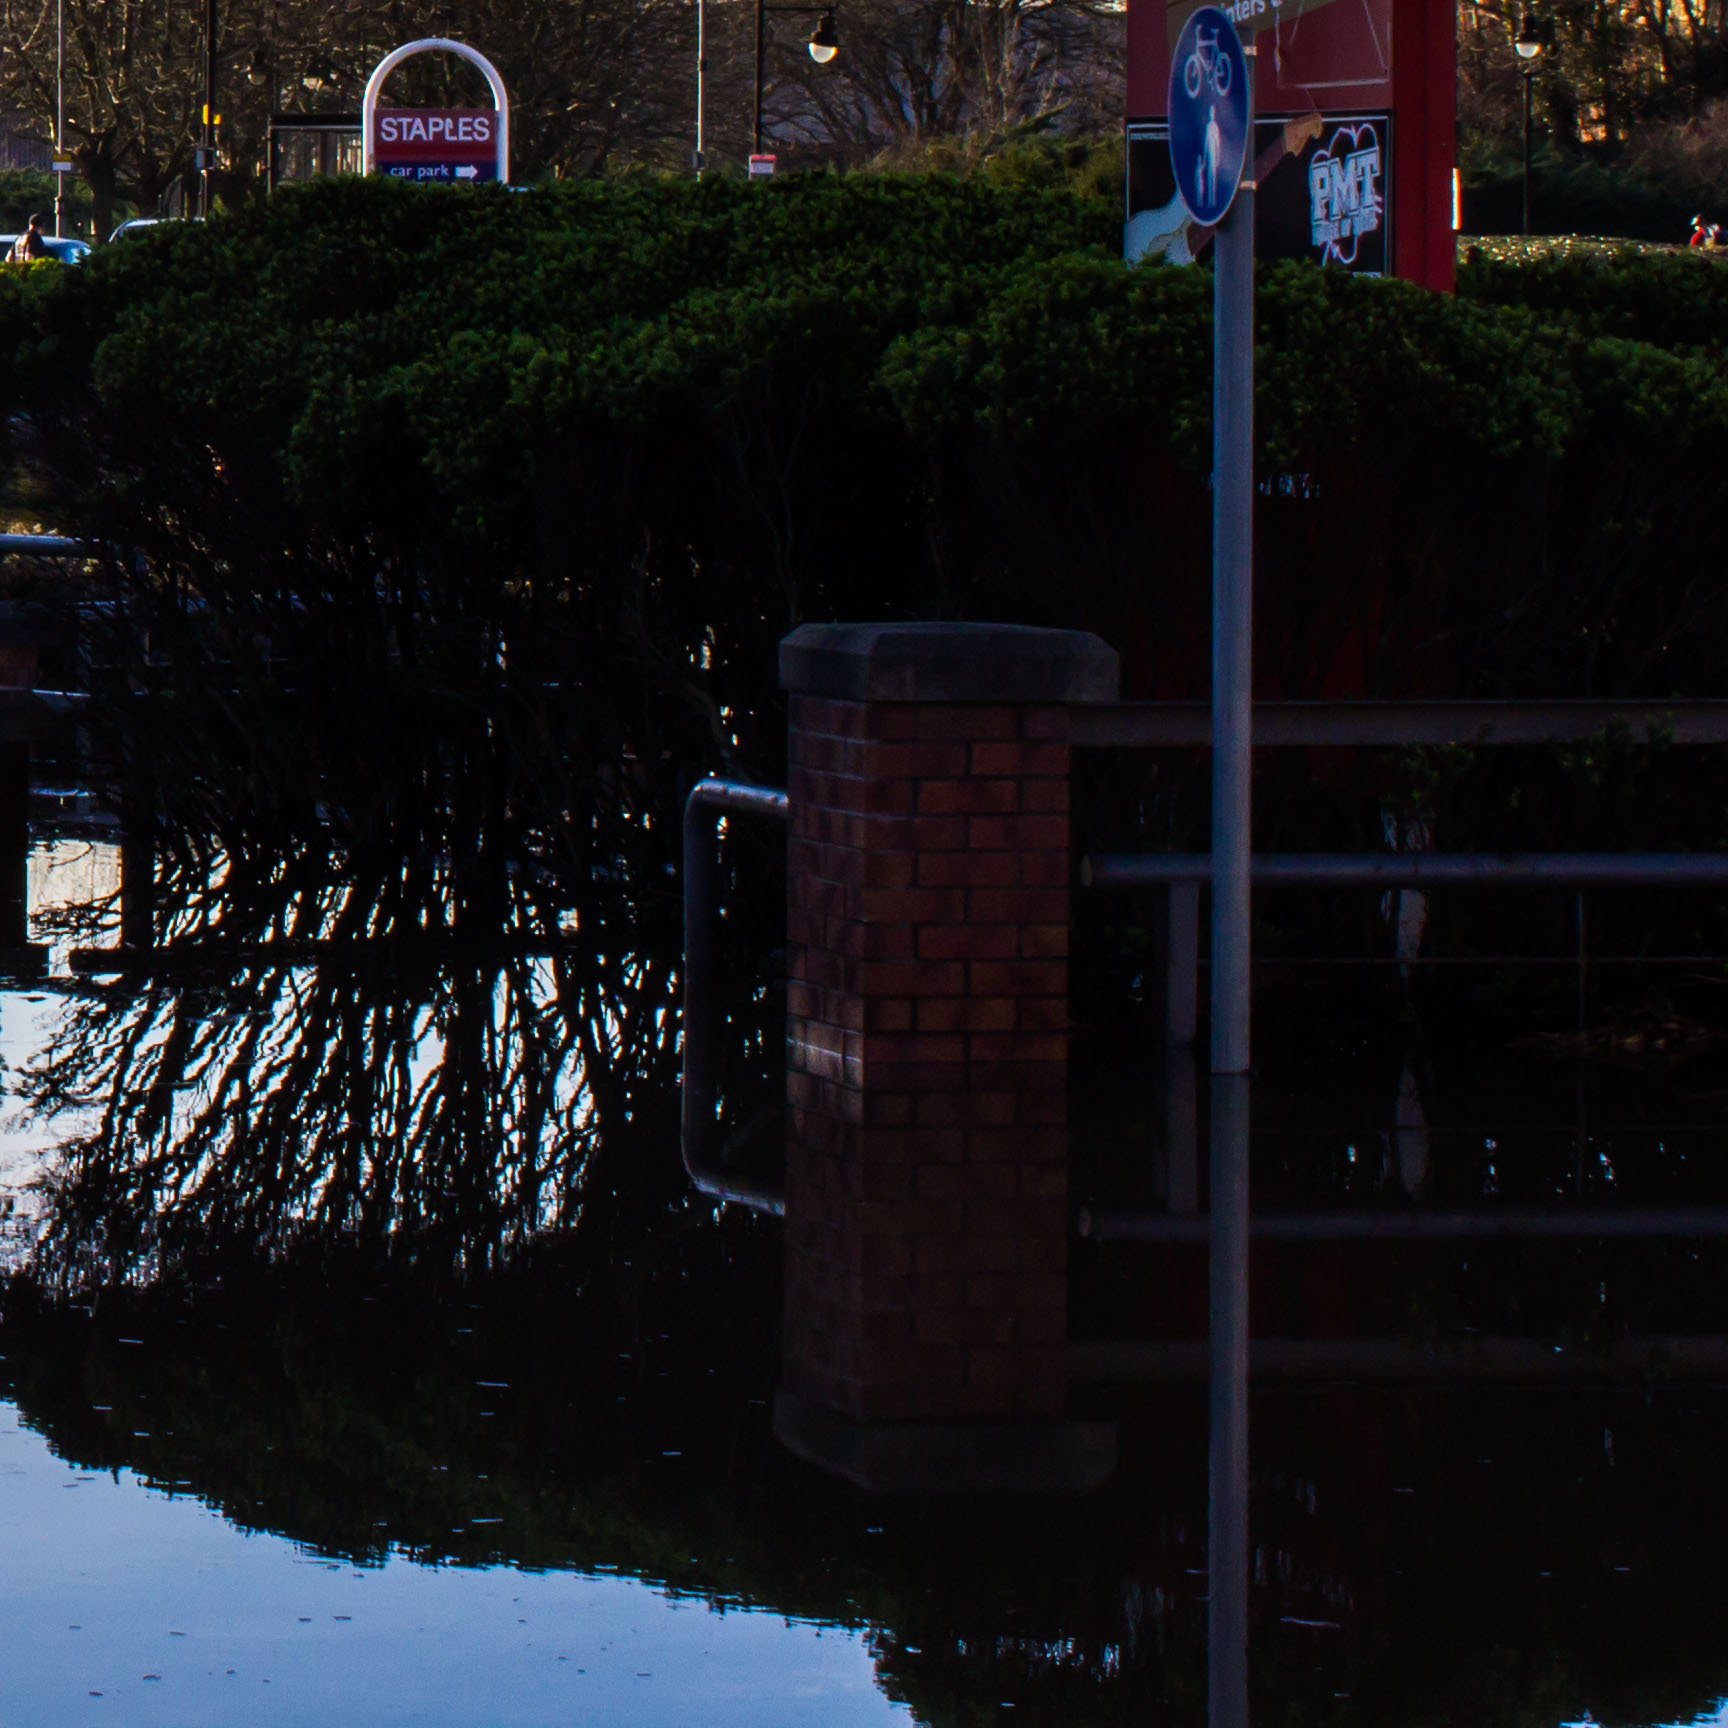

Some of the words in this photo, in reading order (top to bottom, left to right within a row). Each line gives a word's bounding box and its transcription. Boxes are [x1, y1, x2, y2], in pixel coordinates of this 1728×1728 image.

[380, 117, 490, 142] STAPLES
[390, 166, 411, 177] car
[417, 165, 449, 180] park
[1311, 148, 1380, 223] PMT
